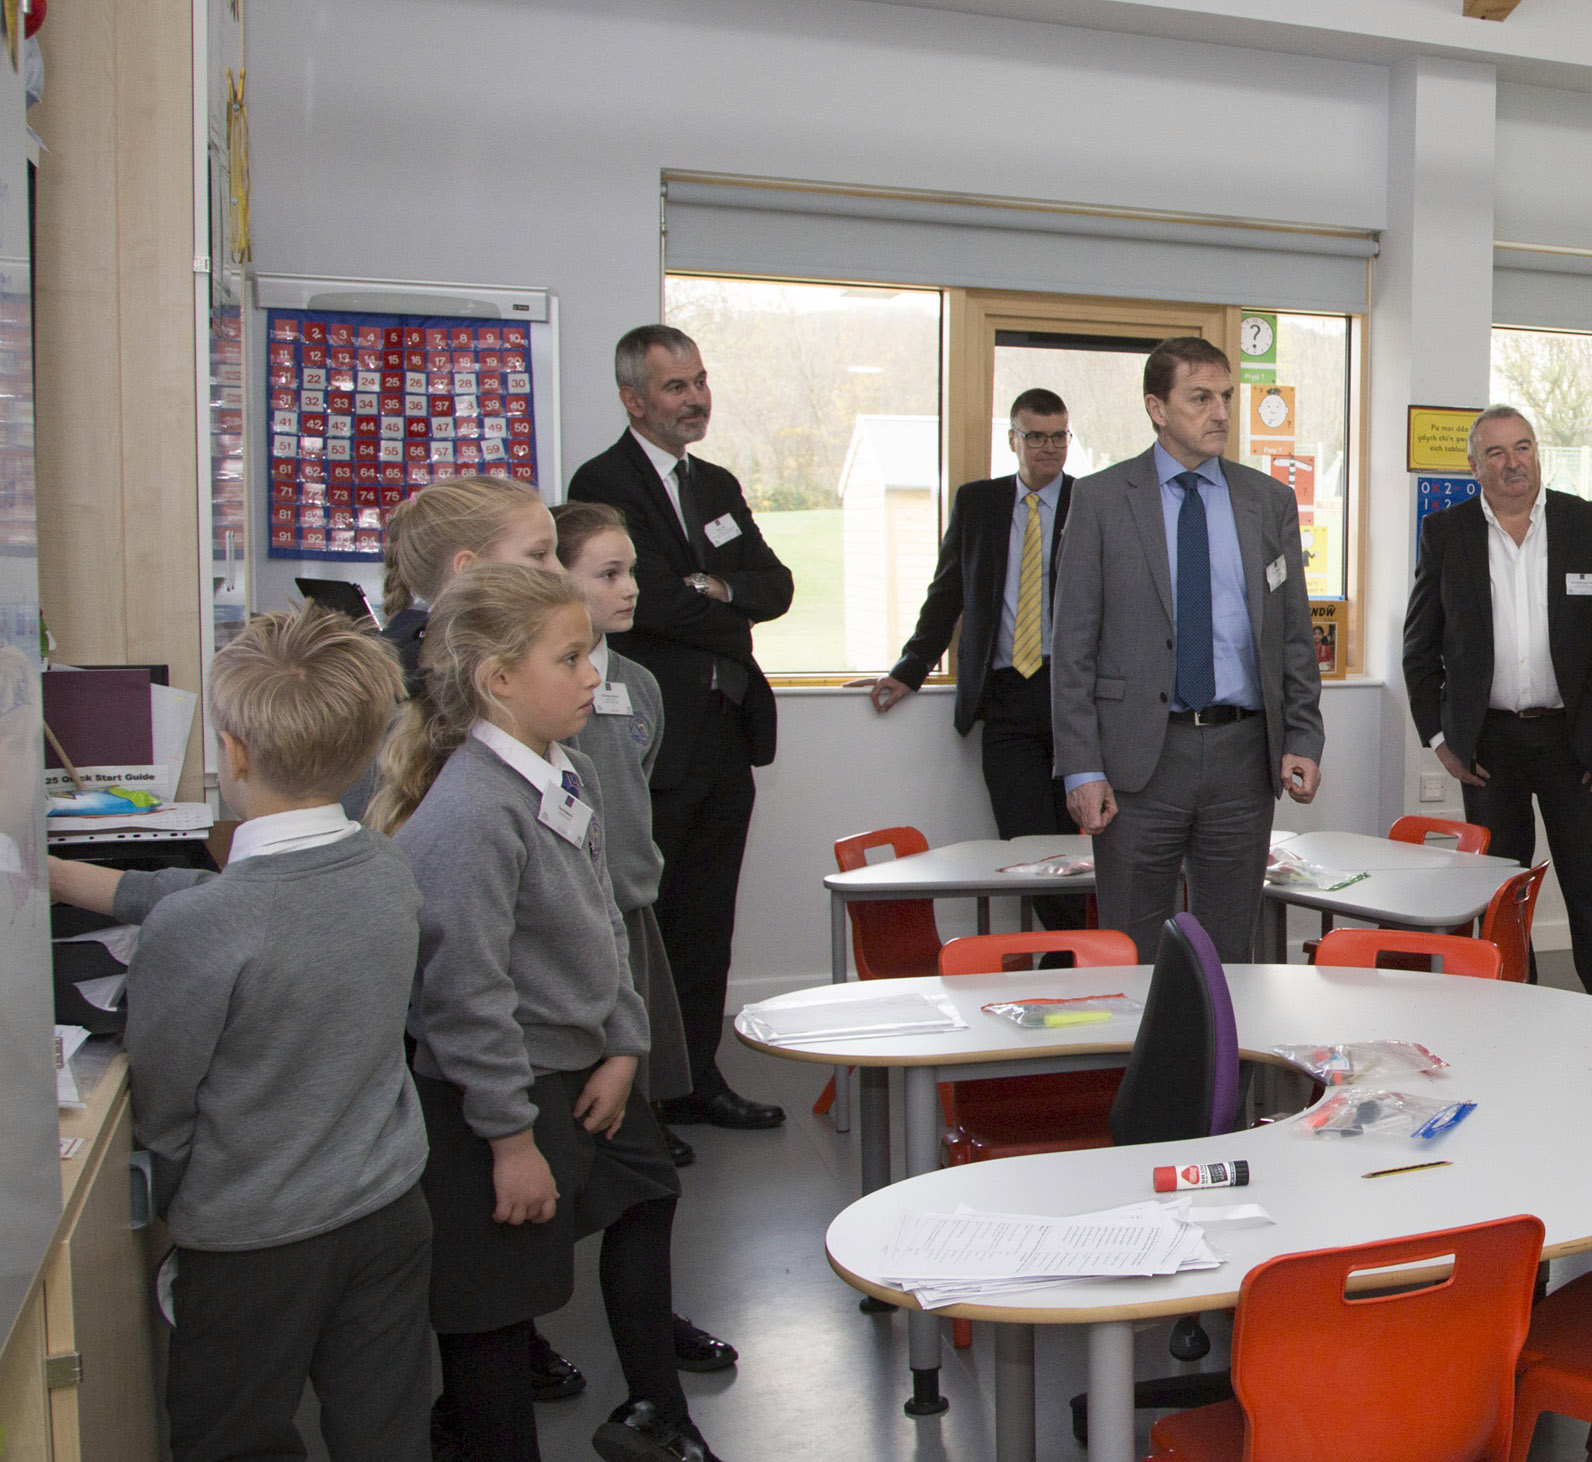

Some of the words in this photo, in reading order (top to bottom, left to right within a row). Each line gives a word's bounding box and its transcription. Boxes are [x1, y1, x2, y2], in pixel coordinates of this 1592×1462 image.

[312, 328, 320, 338] 2
[340, 330, 348, 340] 3
[367, 333, 375, 342] 4
[390, 333, 398, 342] 5
[412, 333, 420, 342] 6
[434, 334, 442, 343] 7
[460, 334, 468, 342] 8
[486, 334, 494, 342] 9
[509, 334, 520, 342] 10
[280, 350, 290, 358] 11
[310, 351, 321, 360] 12
[338, 353, 350, 362] 13
[364, 355, 375, 364] 14
[388, 355, 399, 364] 15
[411, 356, 422, 365] 16
[435, 357, 446, 366] 17
[460, 357, 470, 366] 18
[486, 357, 498, 366] 19
[308, 374, 320, 384] 22
[362, 377, 376, 386] 24
[386, 378, 400, 387] 25
[410, 378, 422, 387] 26
[458, 379, 472, 388] 28
[484, 379, 498, 388] 29
[512, 379, 526, 388] 30
[305, 396, 320, 406] 32
[334, 398, 348, 408] 33
[360, 399, 374, 408] 34
[384, 400, 400, 408] 35
[409, 401, 422, 410] 36
[435, 402, 449, 410] 37
[485, 400, 500, 410] 39
[510, 401, 525, 410] 40
[280, 418, 292, 426] 41
[307, 420, 321, 429] 42
[332, 422, 346, 430] 43
[360, 422, 375, 430] 44
[385, 423, 400, 432] 45
[410, 423, 426, 432] 46
[436, 423, 450, 432] 47
[461, 422, 476, 432] 48
[488, 424, 502, 432] 49
[515, 423, 529, 432] 50
[1418, 434, 1436, 443] ydych
[280, 442, 291, 450] 51
[332, 446, 346, 454] 53
[360, 446, 374, 455] 54
[384, 446, 398, 456] 55
[410, 446, 424, 456] 56
[436, 447, 449, 456] 57
[462, 446, 476, 456] 58
[486, 444, 500, 454] 59
[514, 445, 528, 454] 60
[280, 464, 292, 474] 61
[306, 466, 320, 476] 62
[336, 468, 350, 477] 63
[360, 468, 375, 478] 64
[386, 468, 400, 478] 65
[438, 468, 452, 478] 67
[462, 468, 476, 477] 68
[516, 468, 530, 476] 70
[281, 487, 292, 496] 71
[308, 489, 322, 498] 72
[333, 491, 348, 500] 73
[360, 490, 374, 500] 74
[384, 492, 400, 501] 75
[1422, 482, 1430, 494] 0
[1444, 482, 1452, 494] 2
[1466, 484, 1475, 494] 0
[1424, 498, 1428, 510] 1
[280, 510, 292, 519] 81
[305, 510, 319, 520] 82
[336, 513, 350, 522] 83
[279, 532, 292, 541] 91
[308, 534, 322, 543] 92
[361, 536, 376, 546] 94
[125, 773, 156, 781] Guide
